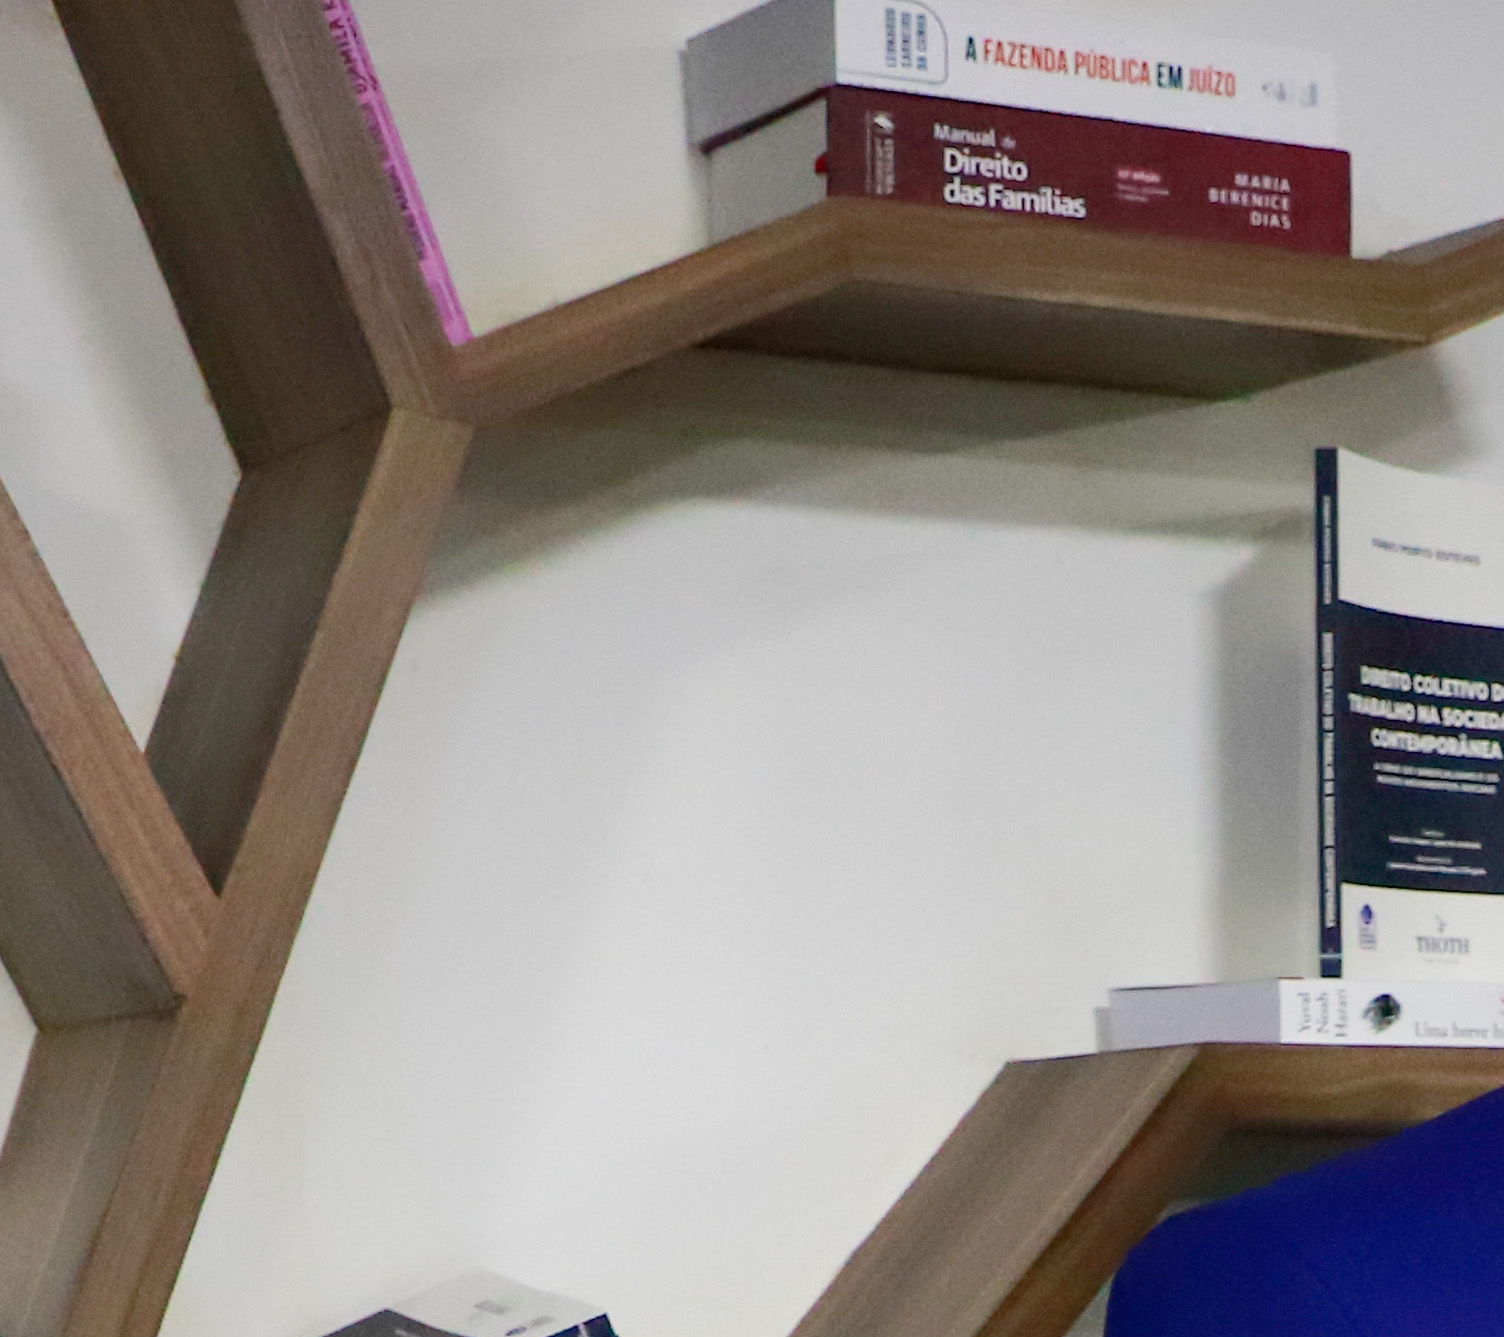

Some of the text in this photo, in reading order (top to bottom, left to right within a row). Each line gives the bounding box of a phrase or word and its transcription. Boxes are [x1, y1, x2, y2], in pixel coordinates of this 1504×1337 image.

[965, 35, 1237, 98] A FAZENDA PÚBLICA EM JUÍZO
[933, 122, 997, 148] Manual
[943, 146, 1029, 182] Direito
[942, 177, 987, 207] das
[987, 182, 1087, 219] Famílias
[1208, 187, 1290, 212] BERENICE
[1234, 173, 1291, 193] MARIA
[1249, 210, 1292, 230] DIAS
[1411, 674, 1490, 701] COLETIVO
[1296, 991, 1312, 1033] Yuval
[1315, 992, 1330, 1034] Noah
[1334, 988, 1348, 1038] Harari
